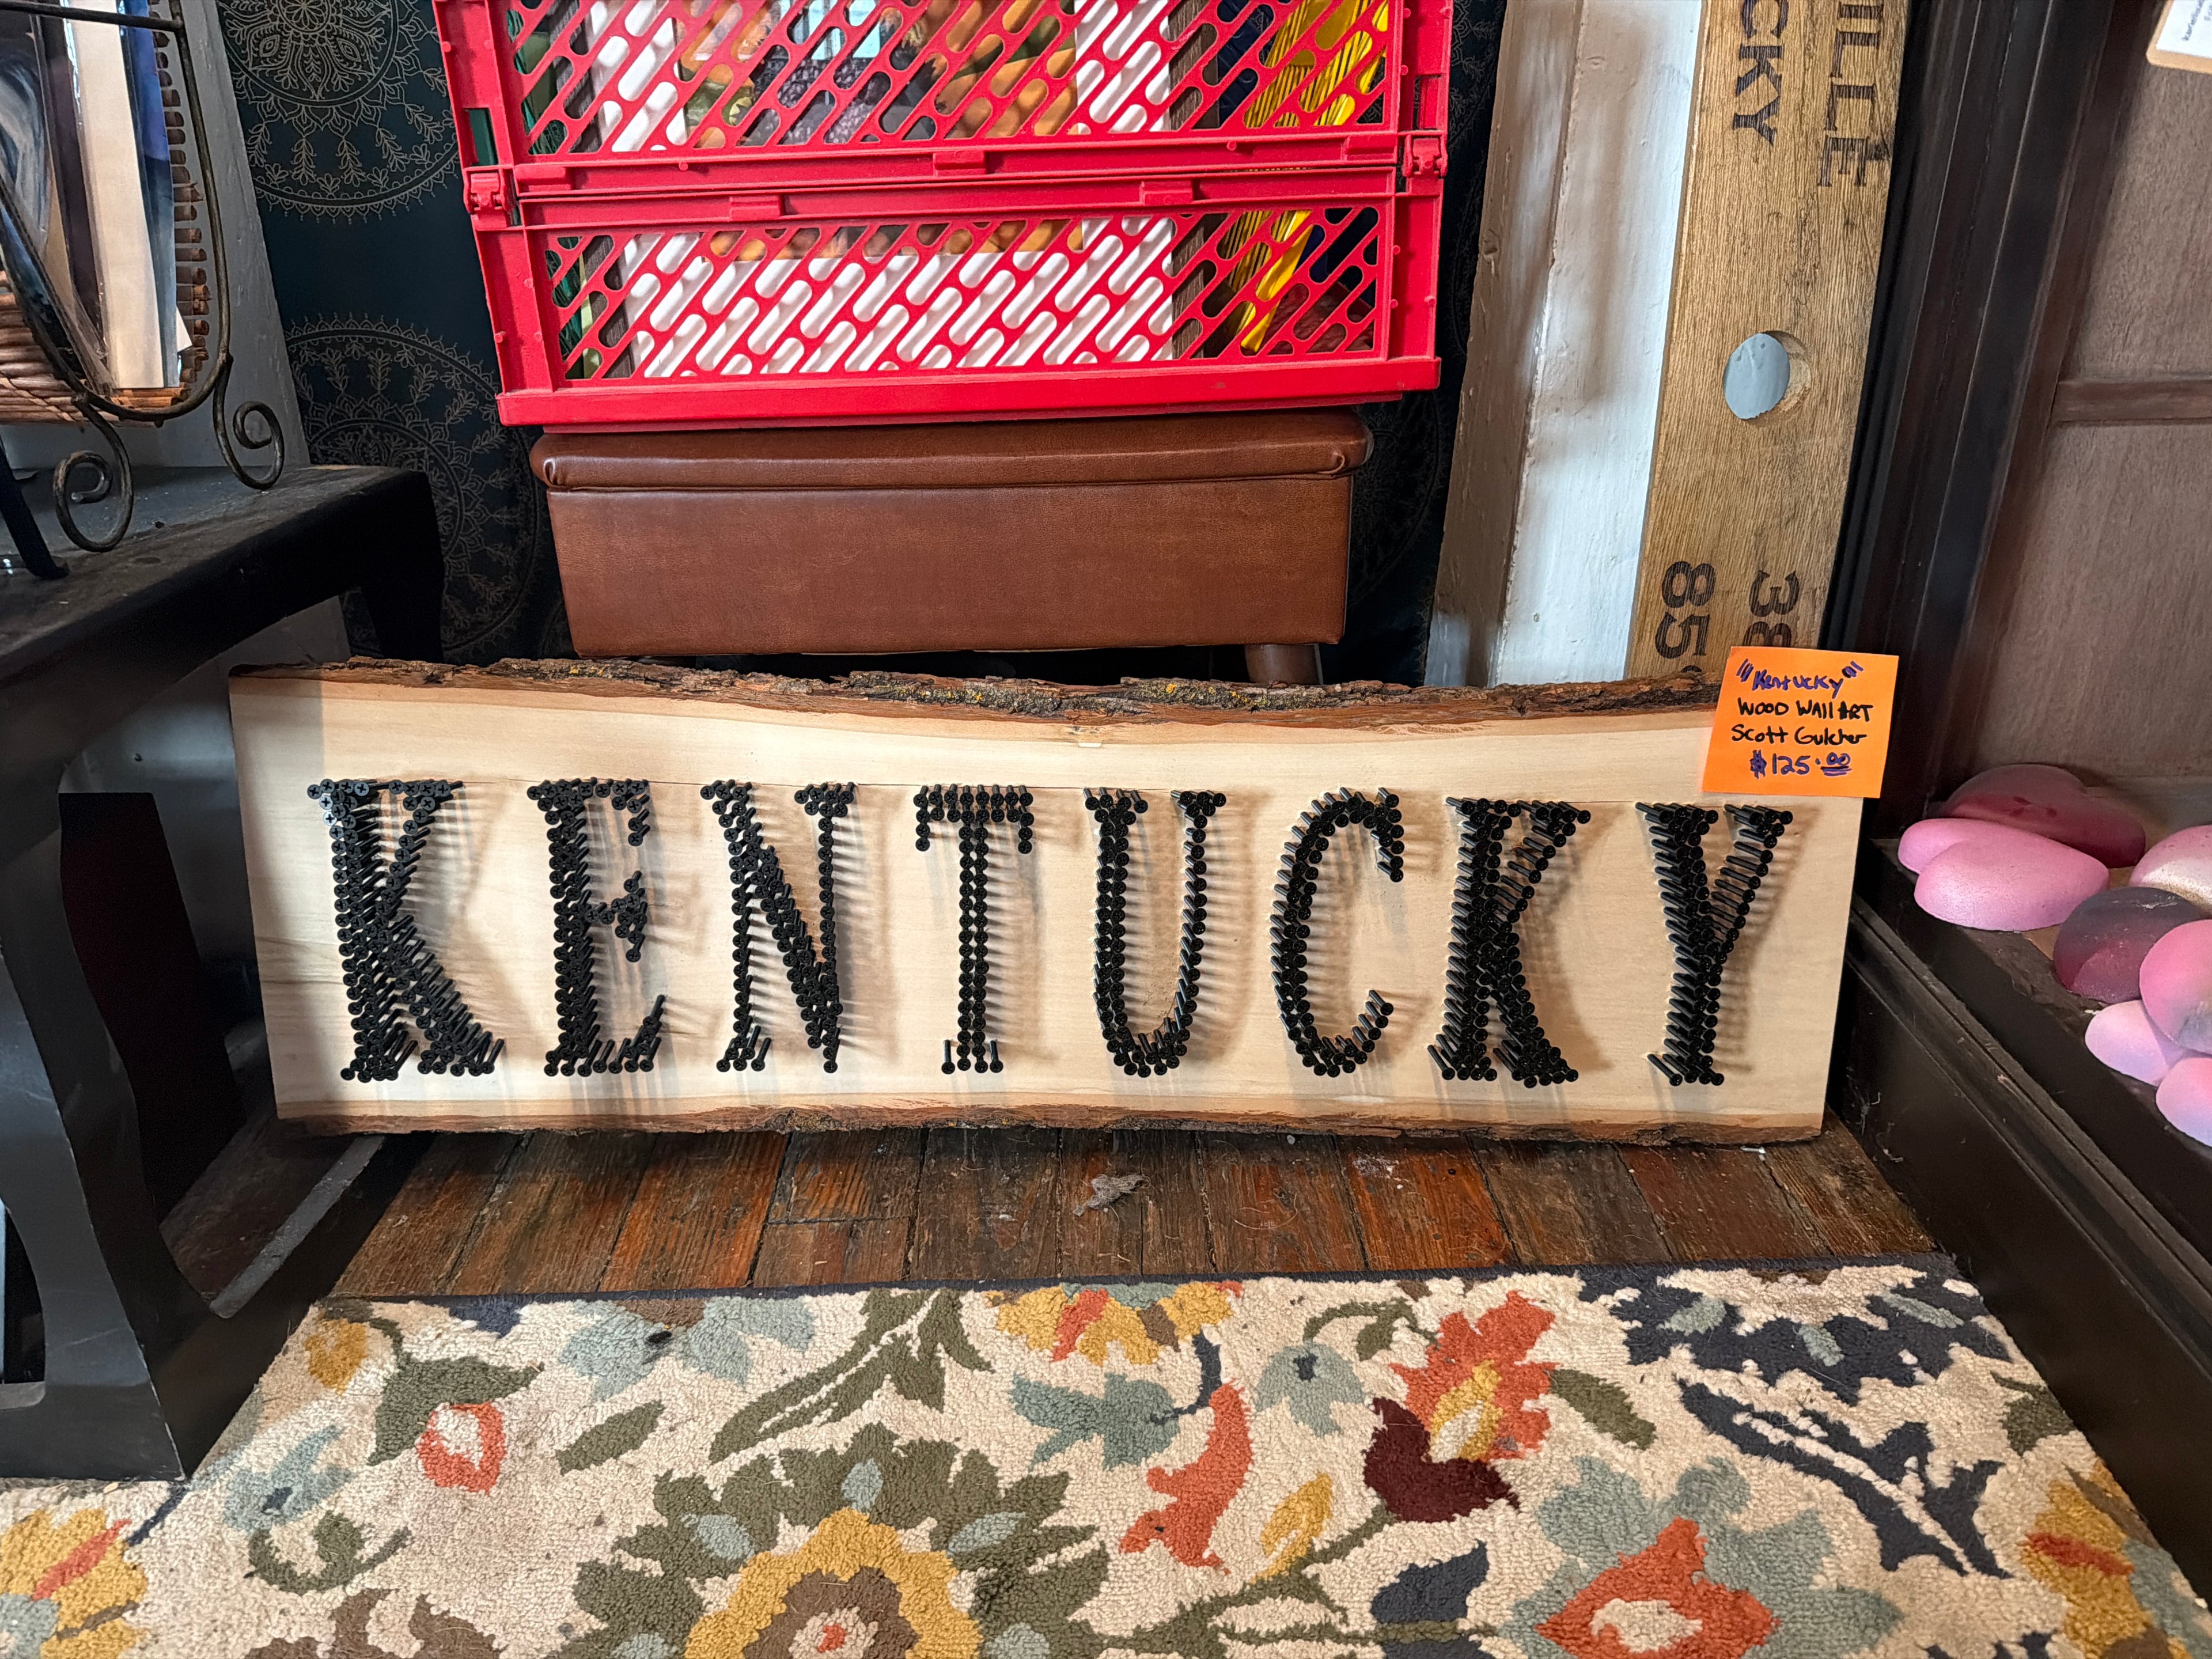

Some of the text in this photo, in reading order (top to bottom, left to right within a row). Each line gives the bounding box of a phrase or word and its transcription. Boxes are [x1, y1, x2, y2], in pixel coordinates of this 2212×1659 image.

[1737, 697, 1789, 716] WOOD
[1731, 724, 1789, 744] Scott
[306, 777, 1794, 1089] KENTUCKY
